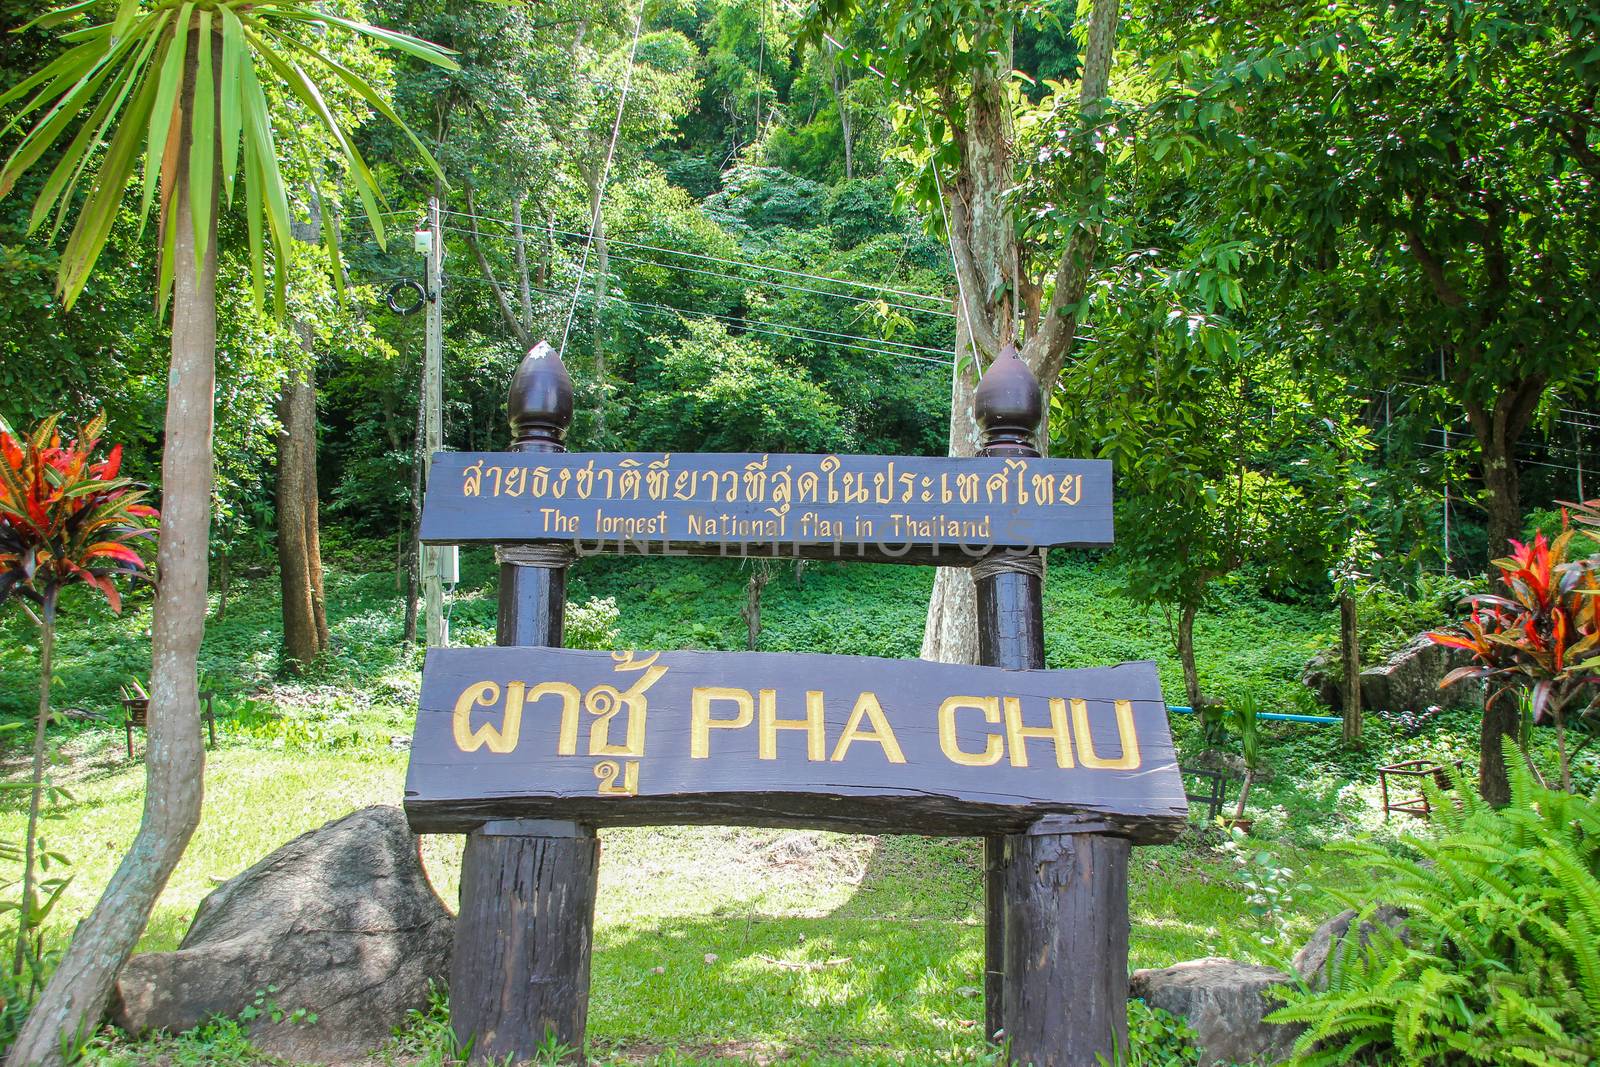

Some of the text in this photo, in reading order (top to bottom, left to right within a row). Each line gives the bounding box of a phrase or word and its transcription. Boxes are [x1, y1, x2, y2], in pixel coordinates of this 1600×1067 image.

[540, 508, 580, 533] The
[687, 513, 785, 537] National
[800, 512, 843, 541] flag
[855, 515, 872, 537] in
[890, 514, 990, 537] Thailand
[453, 651, 1141, 796] ผาชู้ PHA CHU
